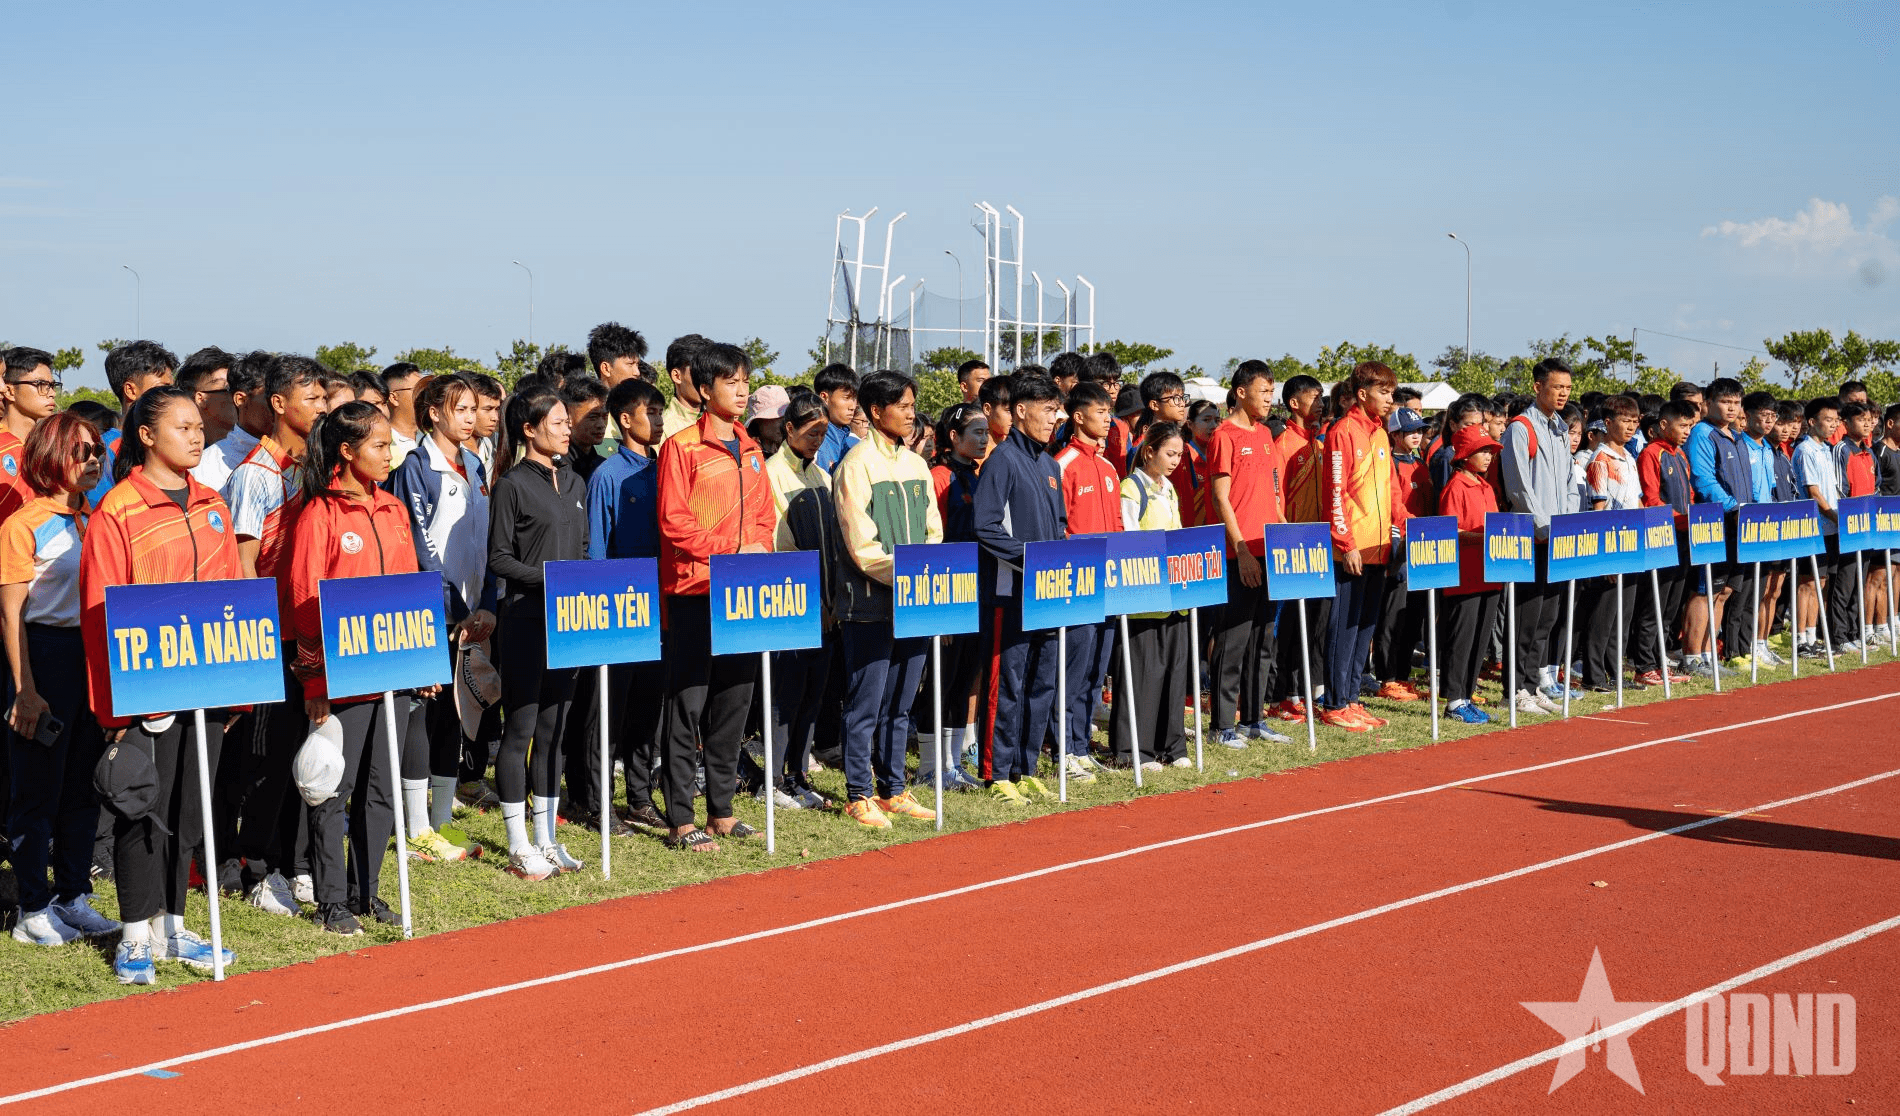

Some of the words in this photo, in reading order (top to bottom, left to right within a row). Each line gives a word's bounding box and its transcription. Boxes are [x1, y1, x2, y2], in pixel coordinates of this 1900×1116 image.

[1332, 451, 1342, 484] NINH
[1410, 531, 1437, 569] QUẢNG
[1437, 539, 1457, 564] NINH
[1489, 527, 1519, 562] QUẢNG
[1519, 536, 1532, 566] TRỊ
[1552, 535, 1576, 560] NINH
[1577, 528, 1599, 557] BÌNH
[1605, 525, 1618, 553] HÀ
[1741, 518, 1759, 543] LÂM
[1120, 556, 1160, 587] NINH
[1167, 552, 1204, 590] TRỌNG
[1204, 545, 1222, 580] TÀI
[1272, 548, 1290, 575] TP.
[1290, 542, 1308, 574] HÀ
[1308, 541, 1329, 579] NỘI
[725, 586, 754, 620] LAI
[758, 576, 807, 618] CHÂU
[896, 575, 912, 607] TP.
[915, 563, 930, 606] HỒ
[932, 566, 950, 605] CHÍ
[952, 572, 977, 604] MINH
[1035, 561, 1073, 604] NGHỆ
[1075, 566, 1095, 597] AN
[556, 591, 609, 632] HƯNG
[613, 585, 650, 628] YÊN
[114, 627, 153, 671] TP.
[159, 614, 198, 668] ĐÀ
[202, 604, 276, 664] NẴNG
[339, 615, 369, 657] AN
[372, 608, 436, 653] GIANG
